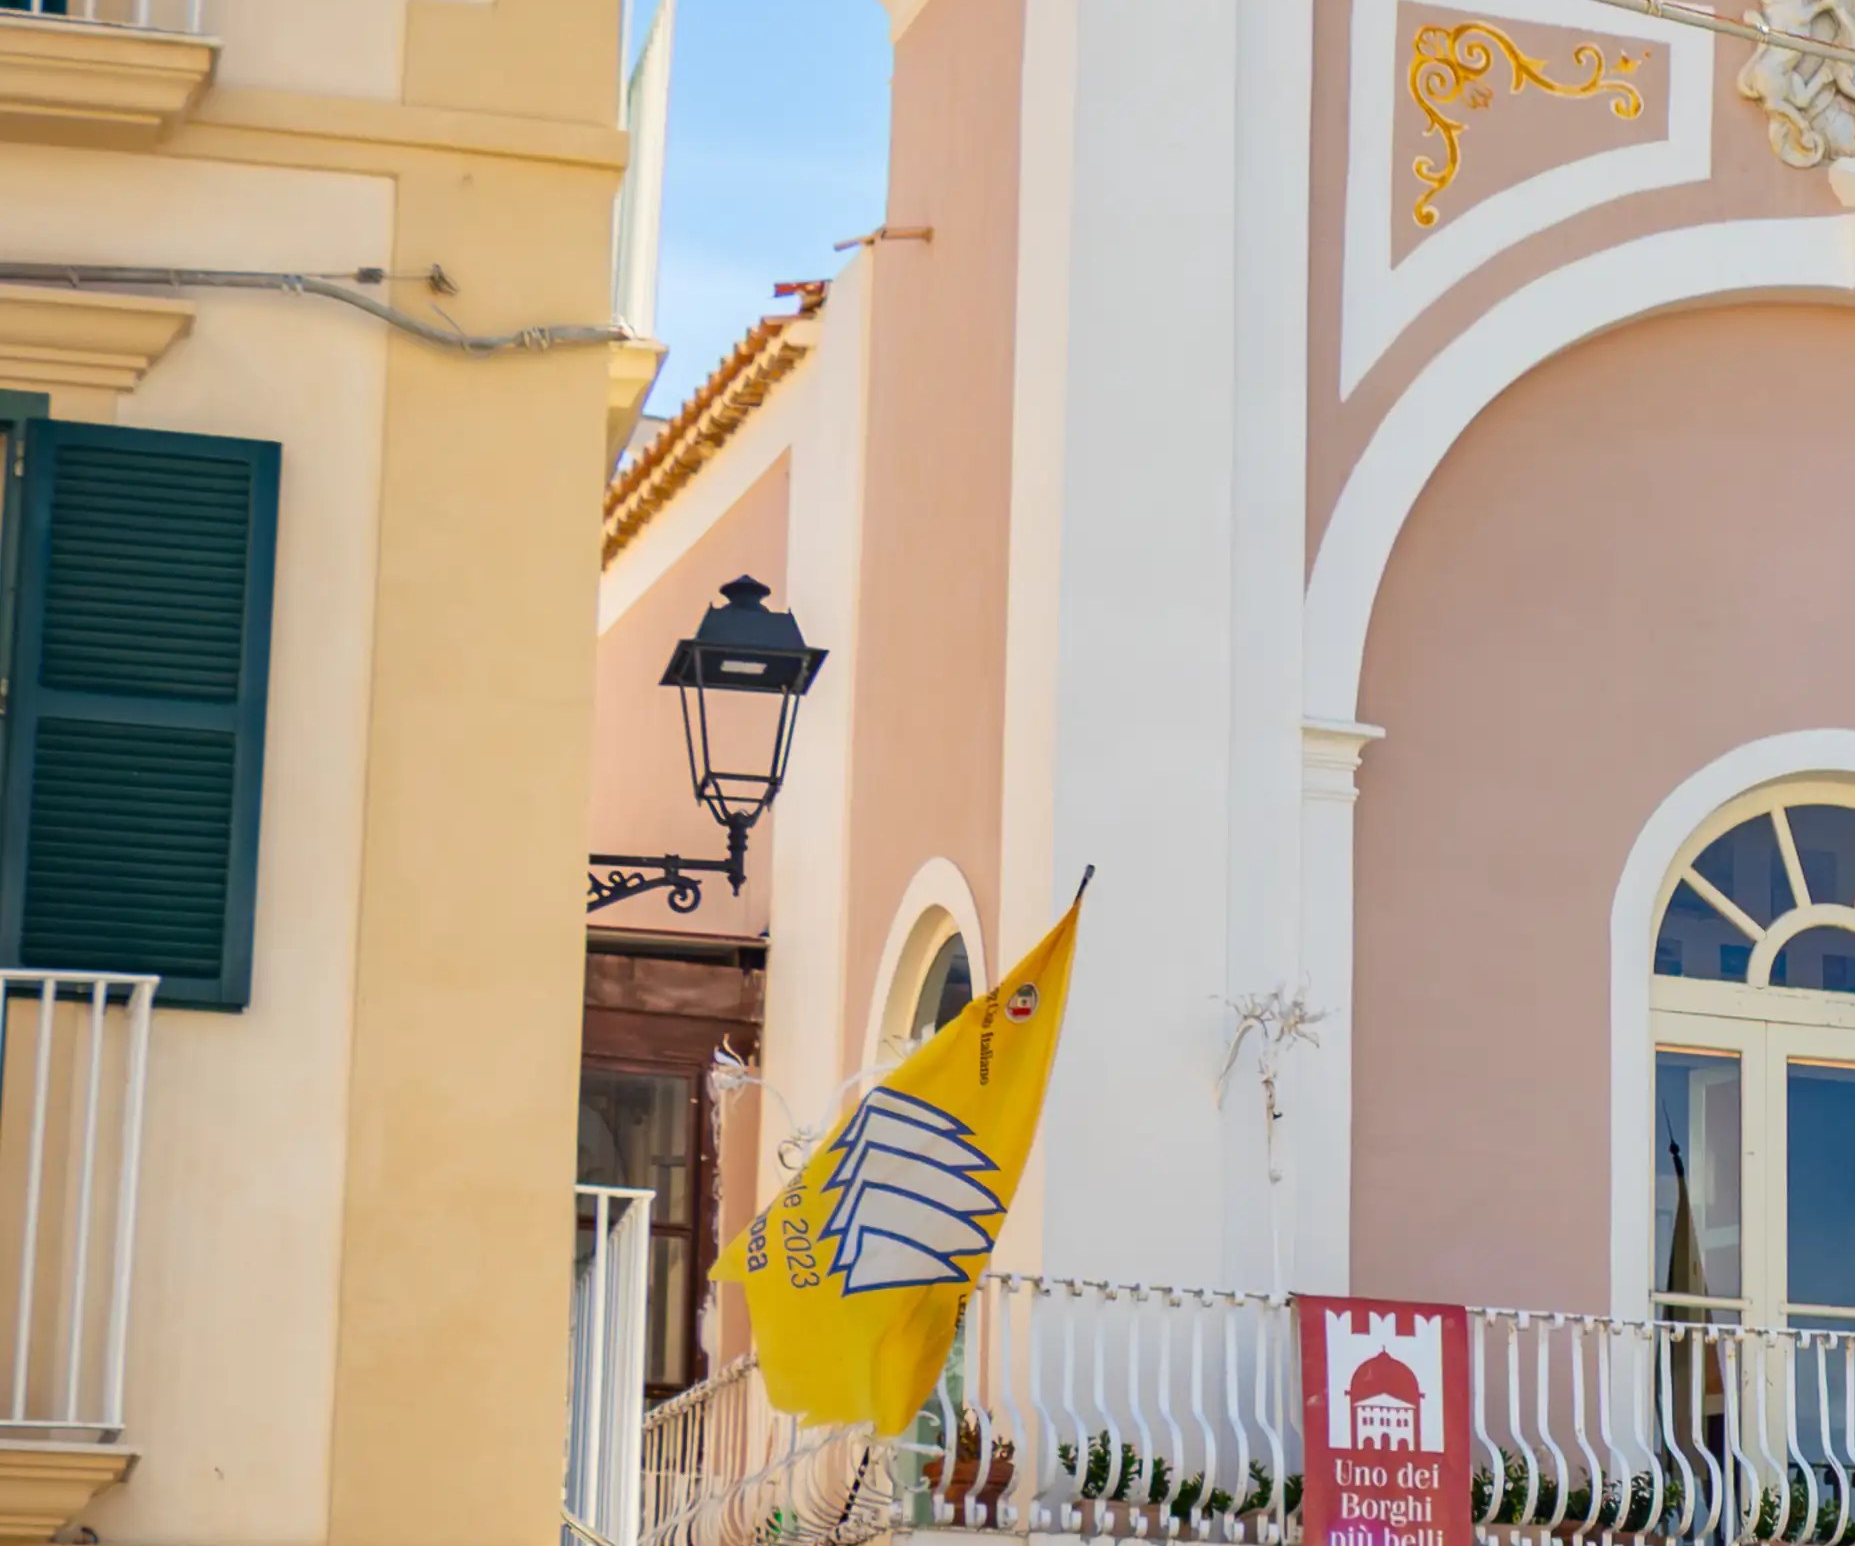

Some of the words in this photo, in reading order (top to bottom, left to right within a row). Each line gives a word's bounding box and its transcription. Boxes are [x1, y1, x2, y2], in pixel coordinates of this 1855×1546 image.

[978, 1032, 995, 1087] Italiano
[782, 1217, 821, 1290] 2023
[1334, 1458, 1388, 1488] Uno
[1396, 1462, 1440, 1490] dei
[1341, 1493, 1433, 1528] Borghi
